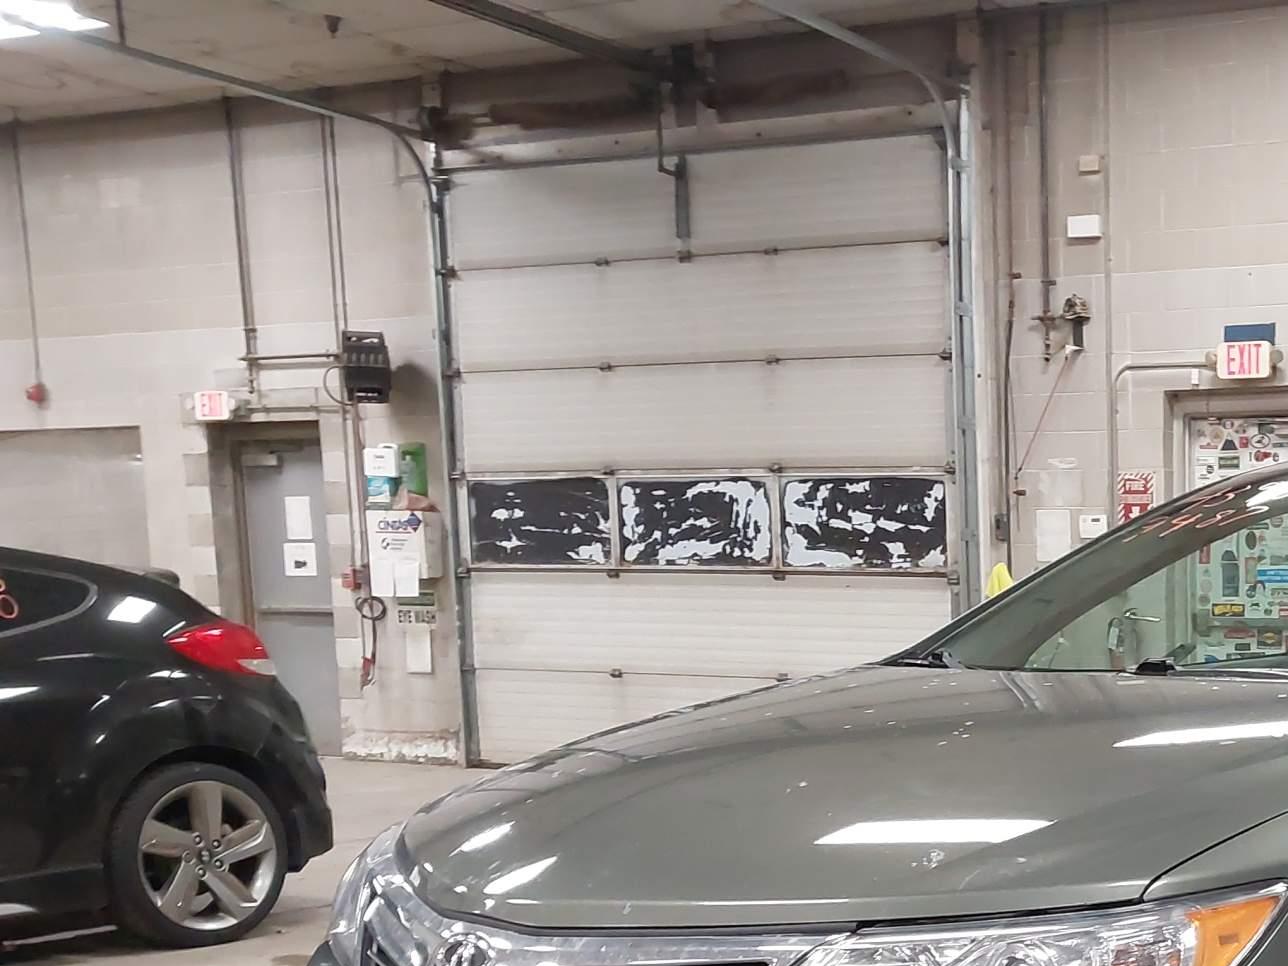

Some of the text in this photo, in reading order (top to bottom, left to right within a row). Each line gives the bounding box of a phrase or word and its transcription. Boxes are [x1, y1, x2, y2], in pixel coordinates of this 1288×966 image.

[1227, 344, 1262, 375] EXIT
[1125, 480, 1145, 491] FIRE
[398, 609, 412, 624] EYE
